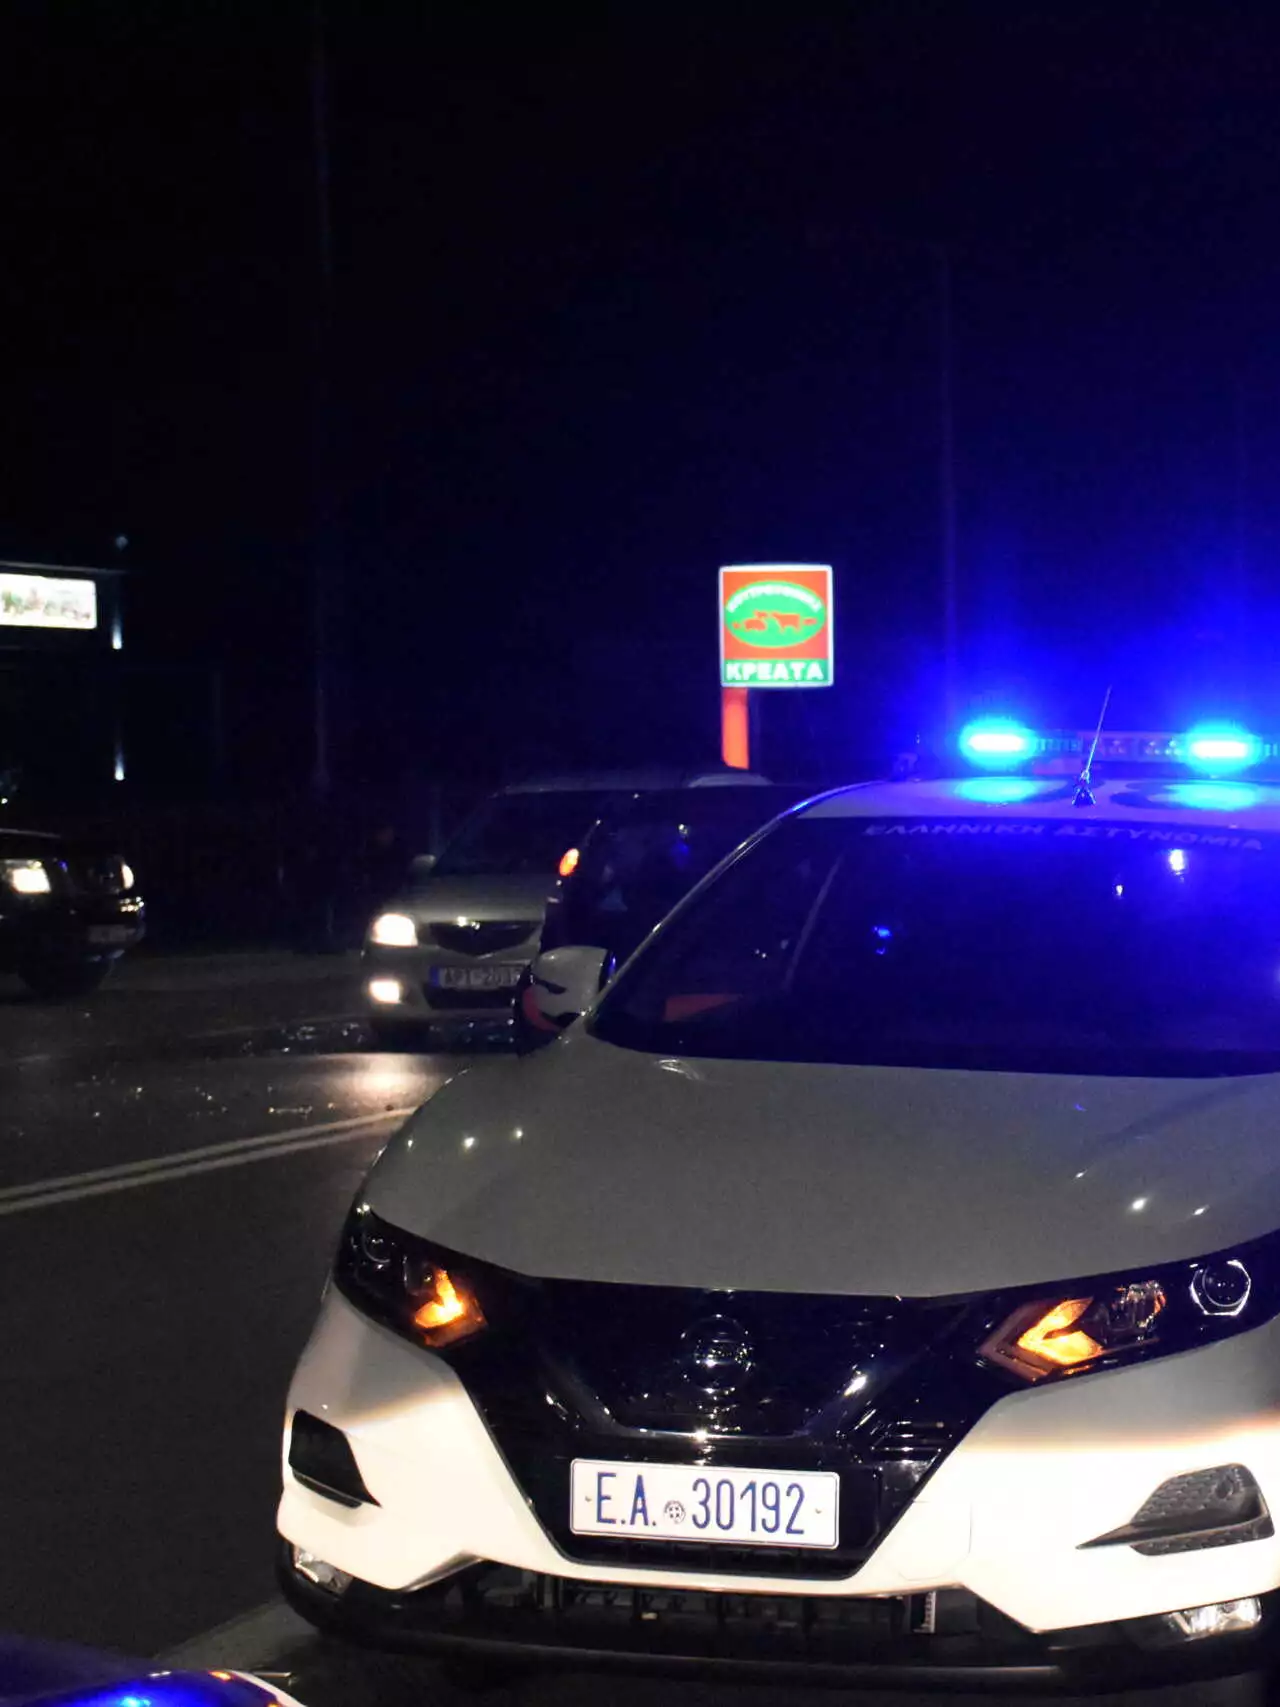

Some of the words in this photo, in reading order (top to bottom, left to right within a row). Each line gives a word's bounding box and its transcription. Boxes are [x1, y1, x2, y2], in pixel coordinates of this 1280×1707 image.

[725, 661, 824, 681] ΚΡΕΑΤΑ
[861, 823, 1045, 837] ΕΛΛΗΝΙΚΗ
[1053, 824, 1263, 851] ΑΣΤΥΝΟΜΙΑ
[691, 1477, 805, 1535] 30192
